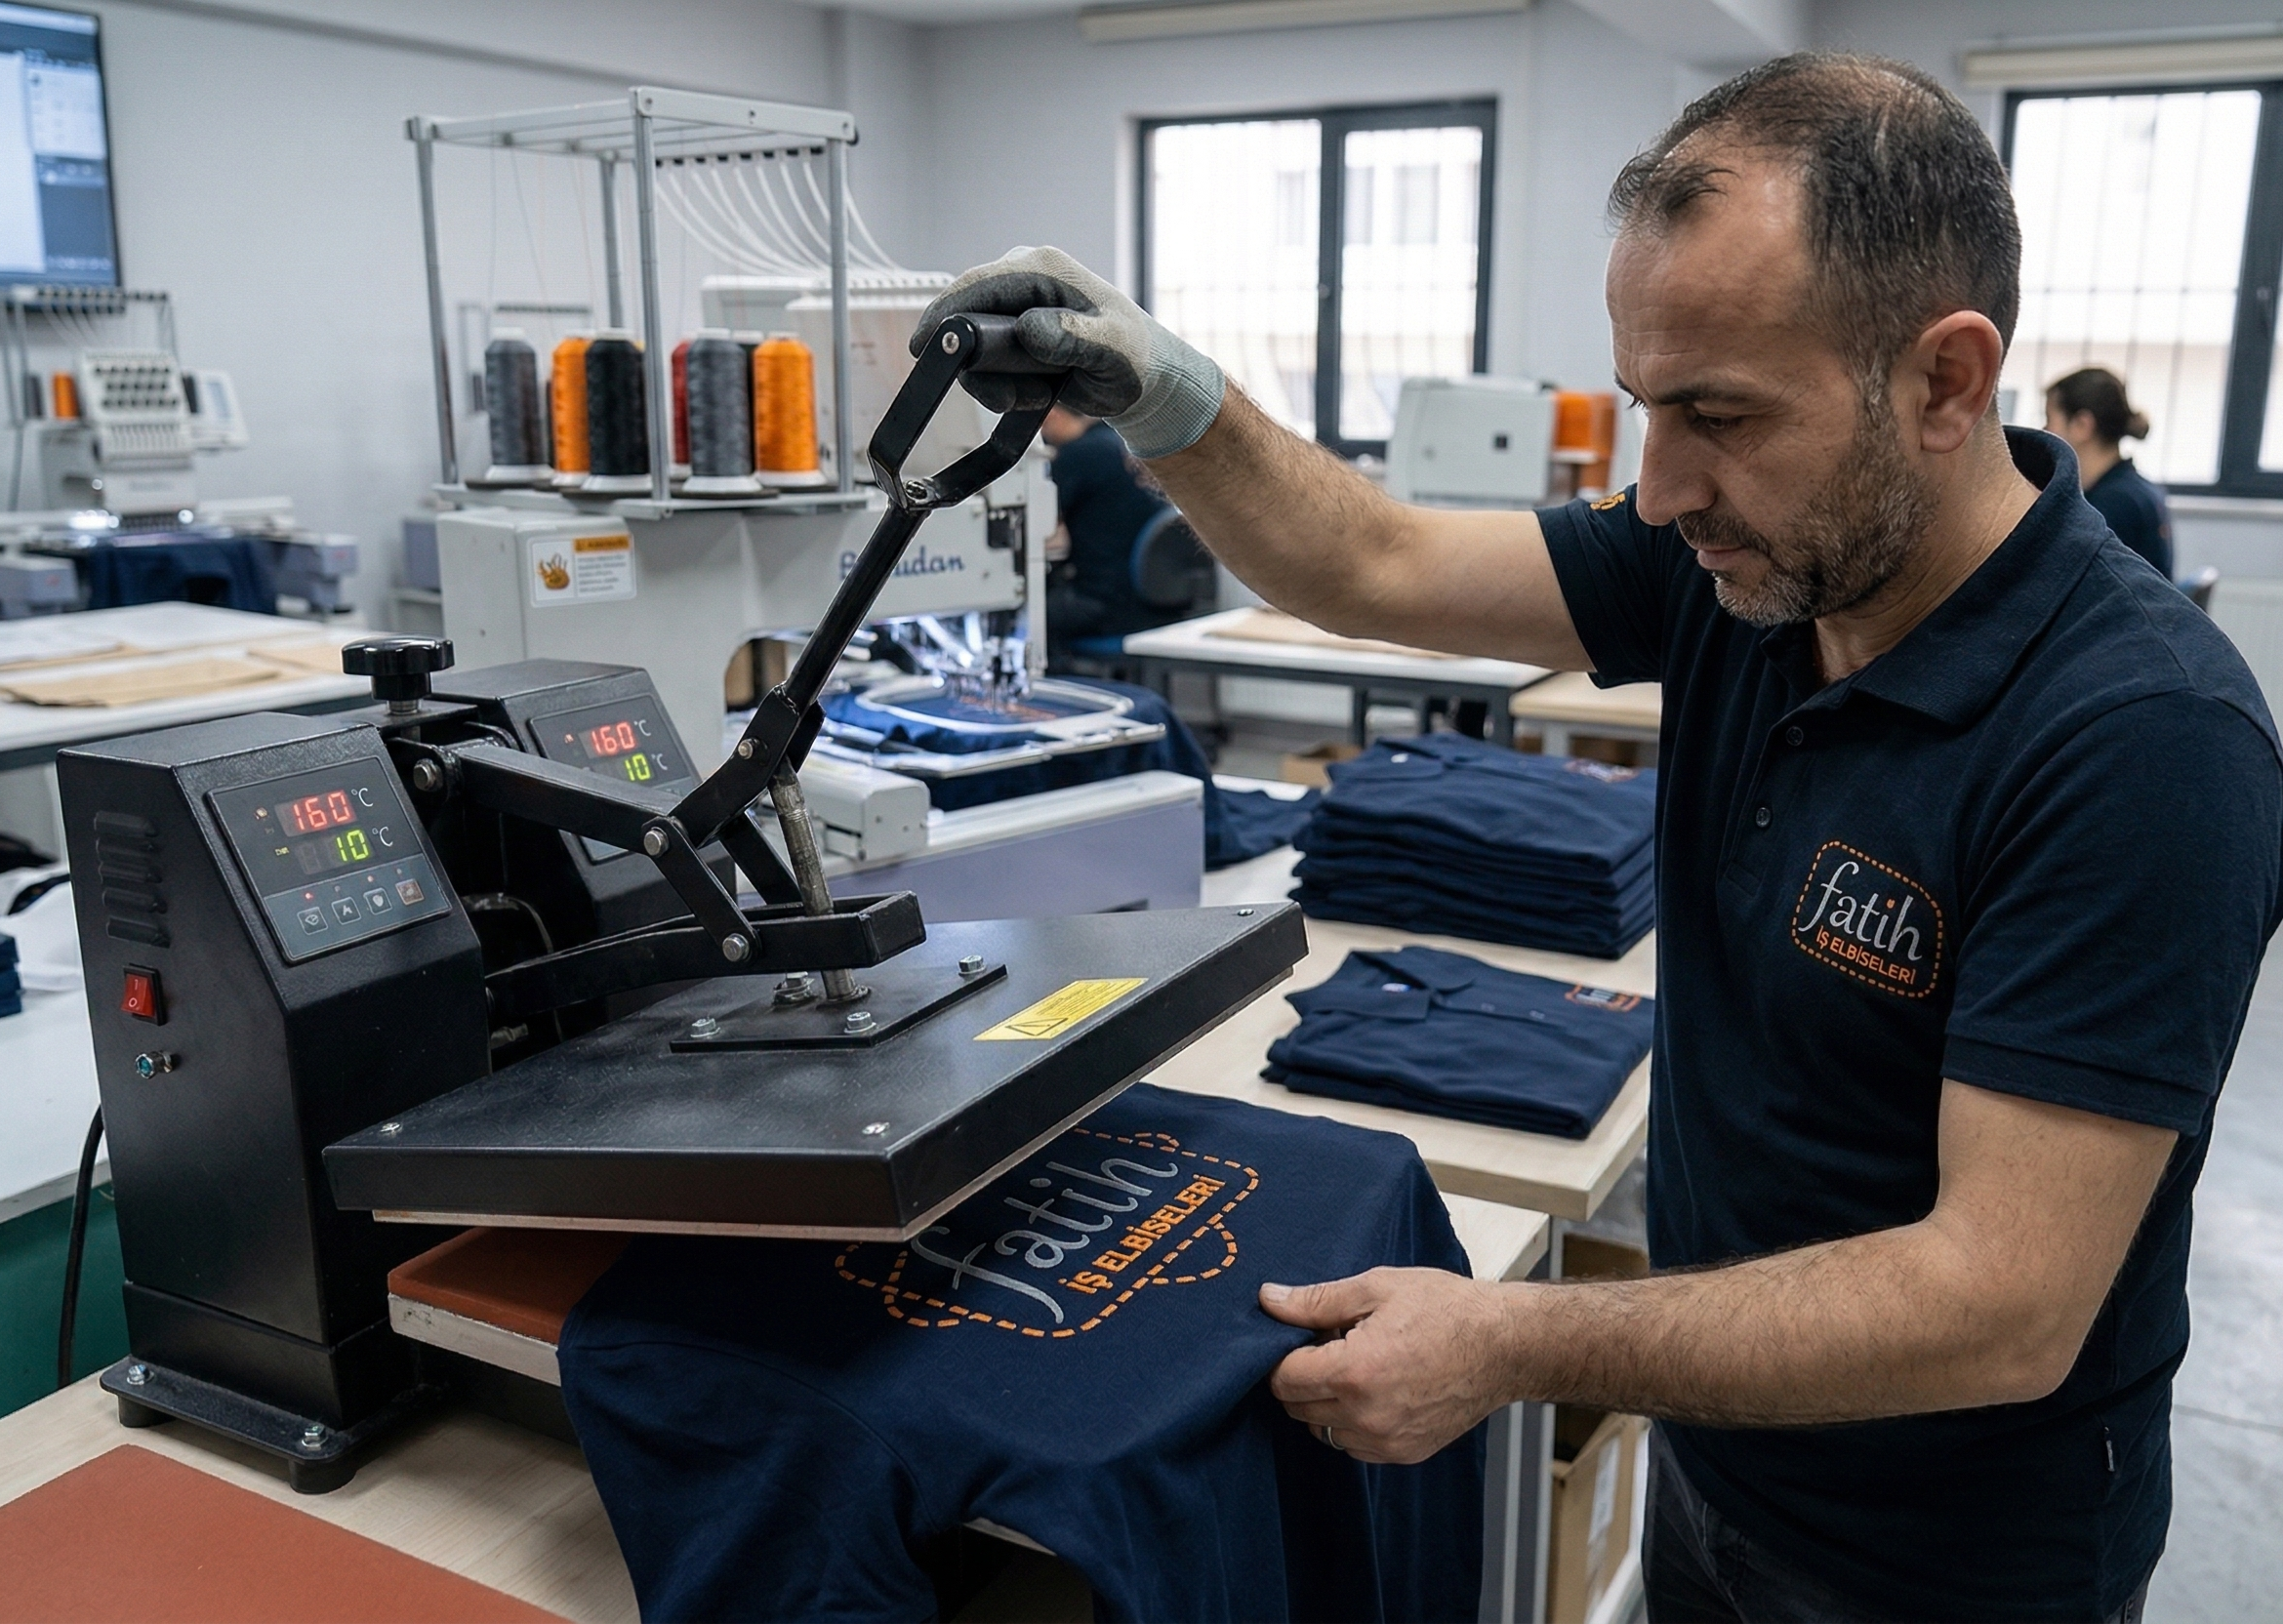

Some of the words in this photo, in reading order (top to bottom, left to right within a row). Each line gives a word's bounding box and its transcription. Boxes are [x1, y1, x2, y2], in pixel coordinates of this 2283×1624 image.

[840, 546, 964, 581] Budan
[591, 721, 636, 755] 160
[624, 752, 651, 781] 10
[292, 792, 352, 831] 160
[350, 788, 374, 807] °C
[335, 830, 370, 862] 10
[372, 827, 393, 847] °C
[1798, 861, 1923, 961] fatih
[910, 1157, 1179, 1324] fatih
[1058, 1271, 1114, 1294] İŞ
[1092, 1174, 1226, 1273] ELBİSELERİ
